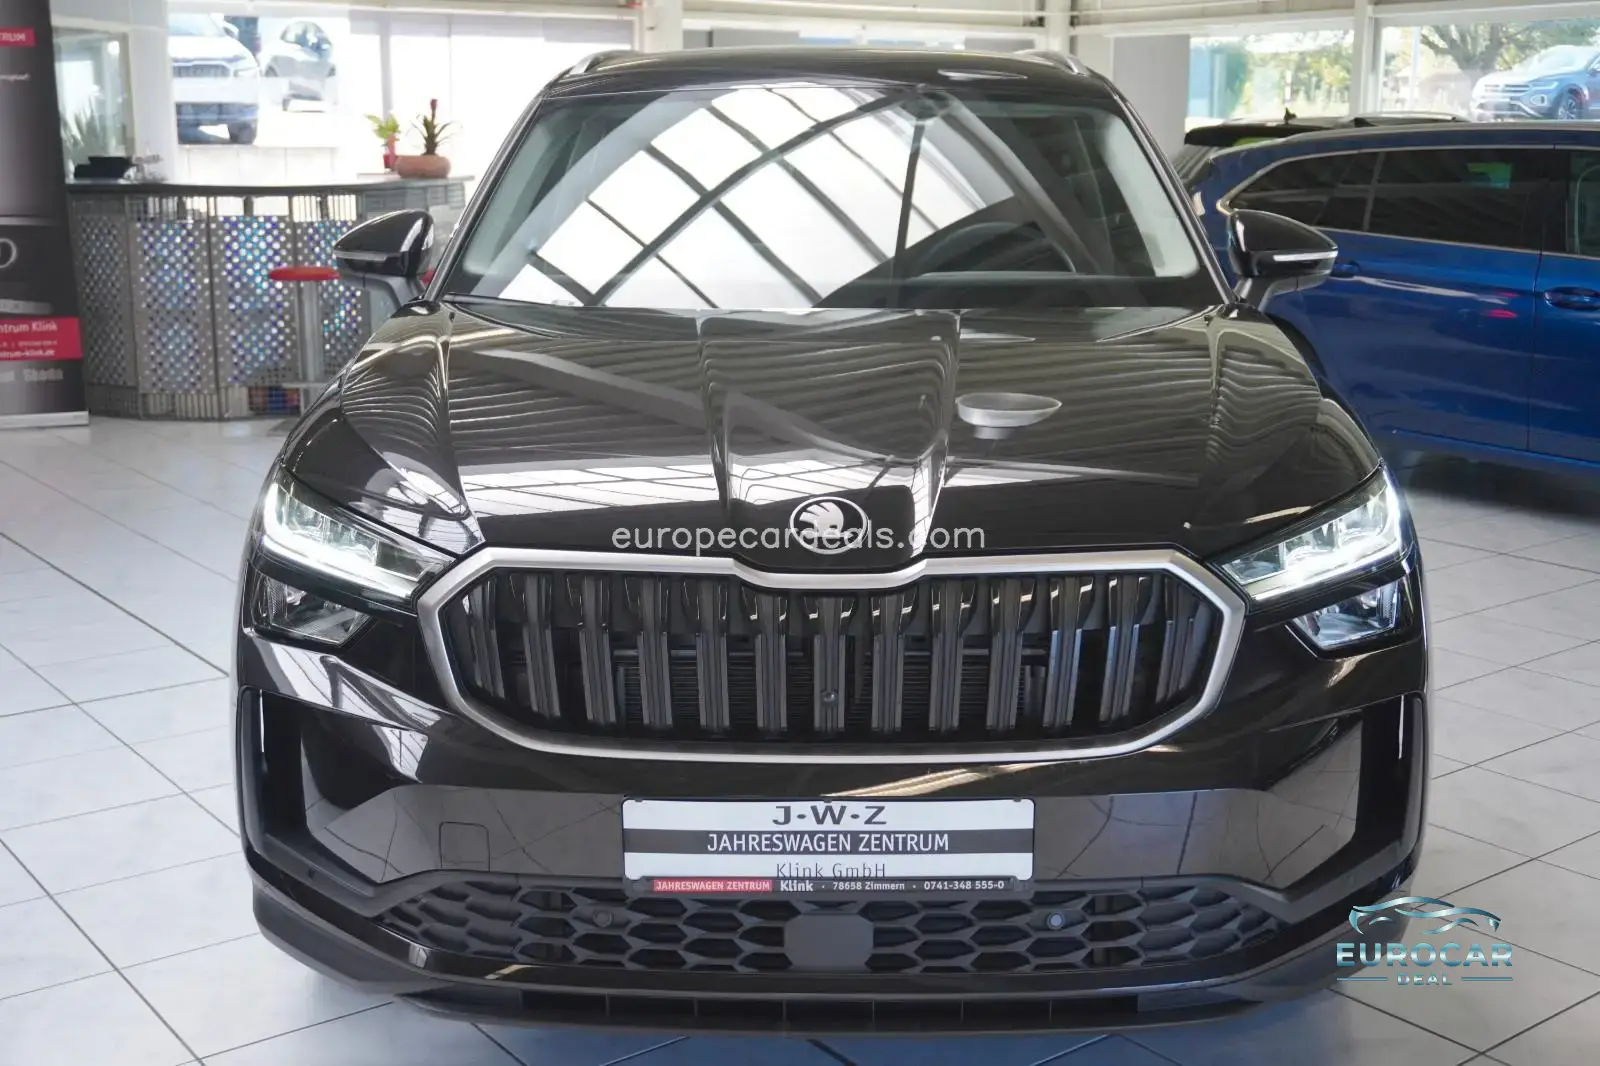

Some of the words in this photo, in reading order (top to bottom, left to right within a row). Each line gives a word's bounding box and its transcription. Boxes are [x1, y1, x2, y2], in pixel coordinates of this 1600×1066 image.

[31, 320, 58, 332] Klink
[707, 833, 851, 852] JAHRESWAGEN
[858, 833, 949, 852] ZENTRUM
[776, 862, 824, 878] Klink
[832, 863, 886, 878] GmbH
[656, 881, 724, 891] JAHRESWAGEN
[726, 881, 770, 891] ZENTRUM
[780, 880, 814, 892] Klink
[832, 881, 862, 891] 78658
[865, 881, 905, 891] Zimmern
[923, 880, 972, 890] 0741-348
[975, 880, 1005, 890] 555-0
